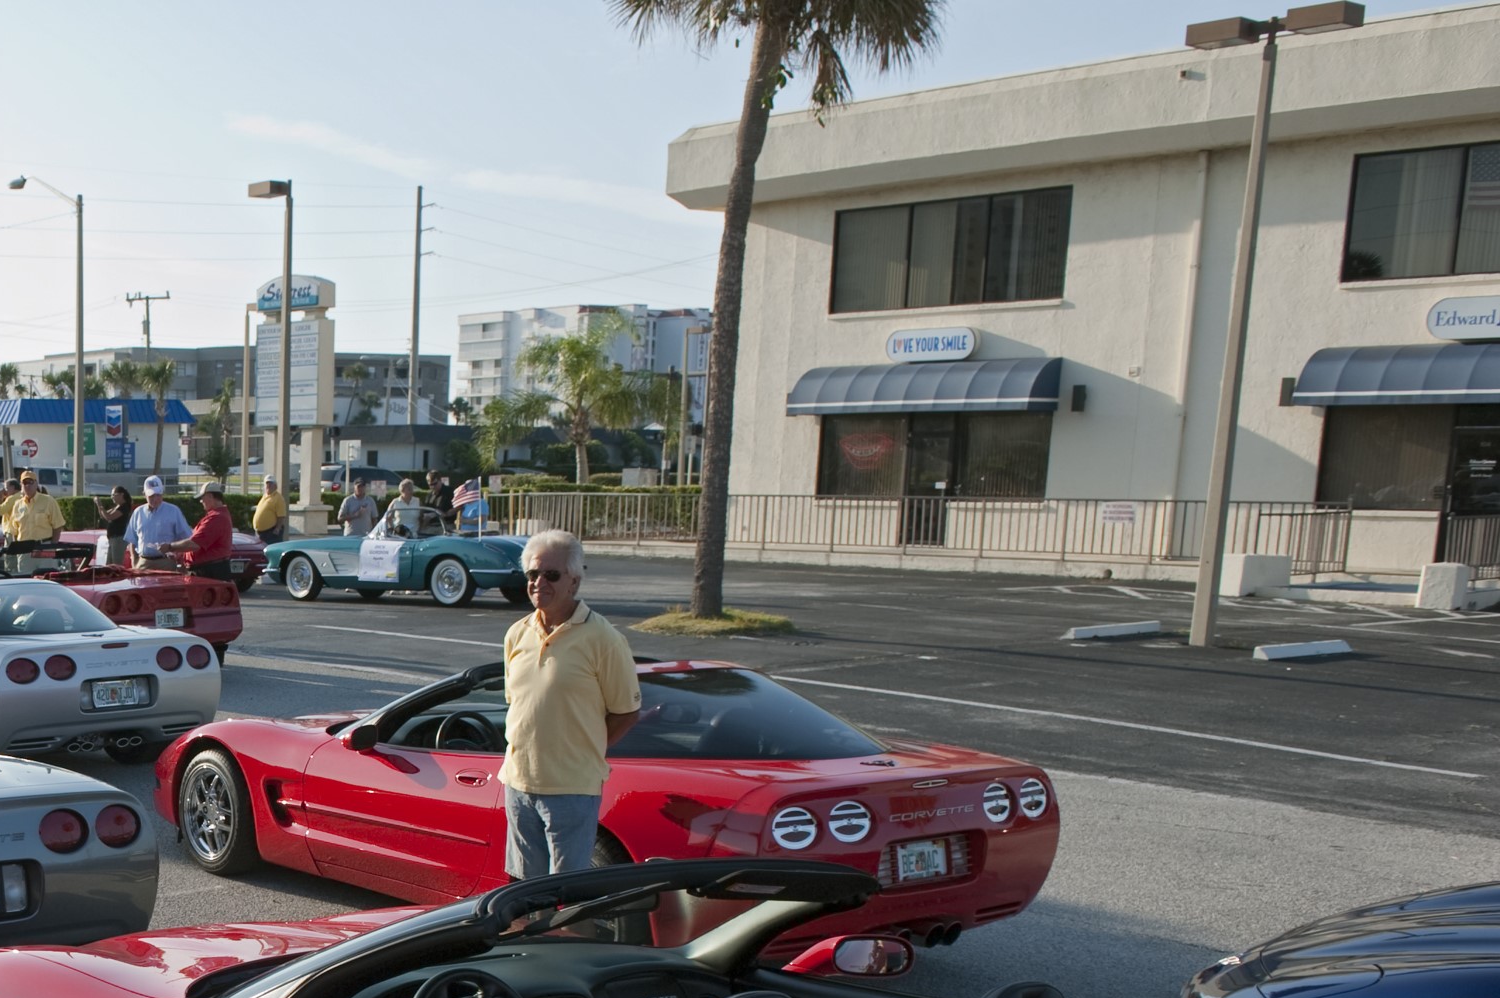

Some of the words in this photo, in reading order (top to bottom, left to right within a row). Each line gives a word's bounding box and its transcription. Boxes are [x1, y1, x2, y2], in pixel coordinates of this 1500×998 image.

[262, 283, 312, 302] Serest
[1435, 309, 1497, 327] Edward
[915, 337, 940, 353] YOUR
[941, 335, 968, 352] SMILE
[96, 688, 110, 701] 420
[889, 804, 975, 823] CORVETTE
